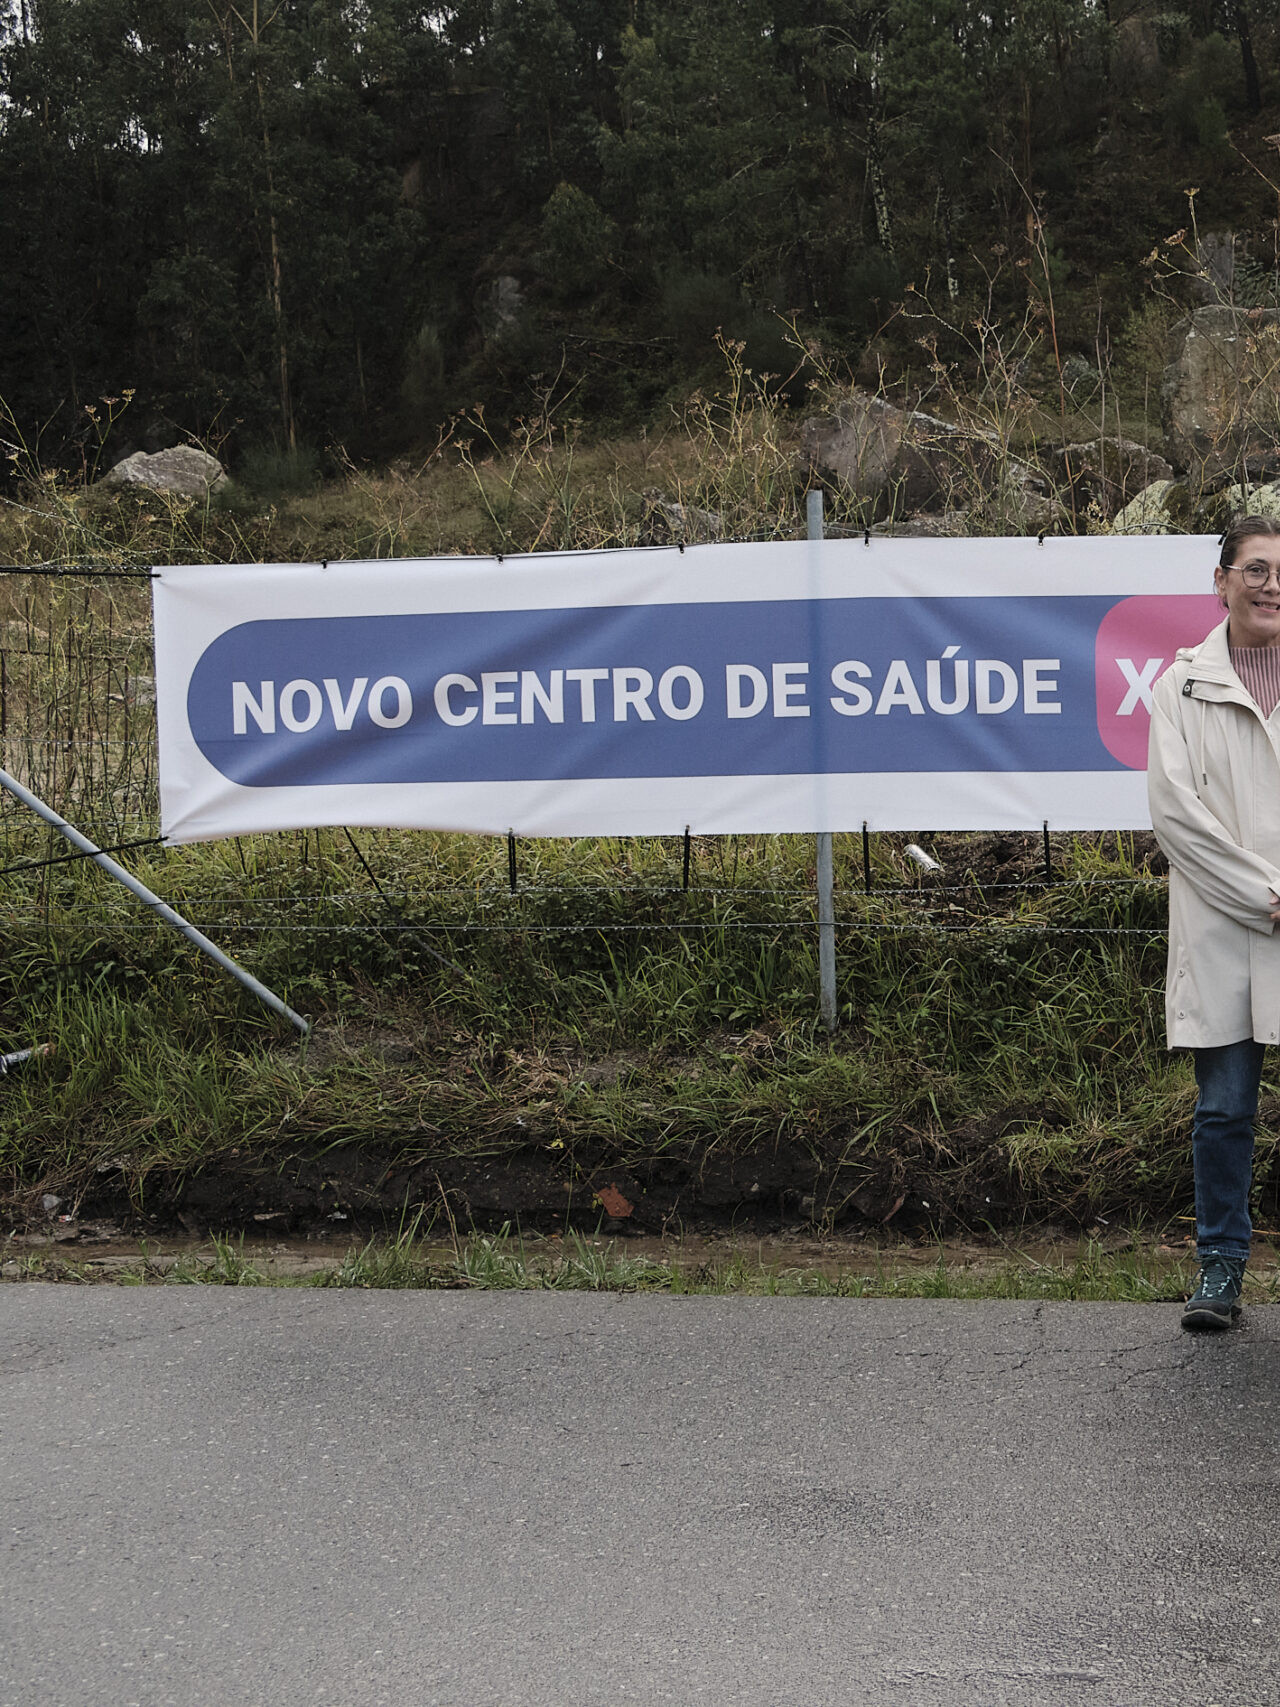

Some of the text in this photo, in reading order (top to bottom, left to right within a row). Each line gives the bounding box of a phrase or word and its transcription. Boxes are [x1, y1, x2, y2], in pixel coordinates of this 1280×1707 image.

[232, 646, 1164, 735] NOVO CENTRO DE SAÚDE X
